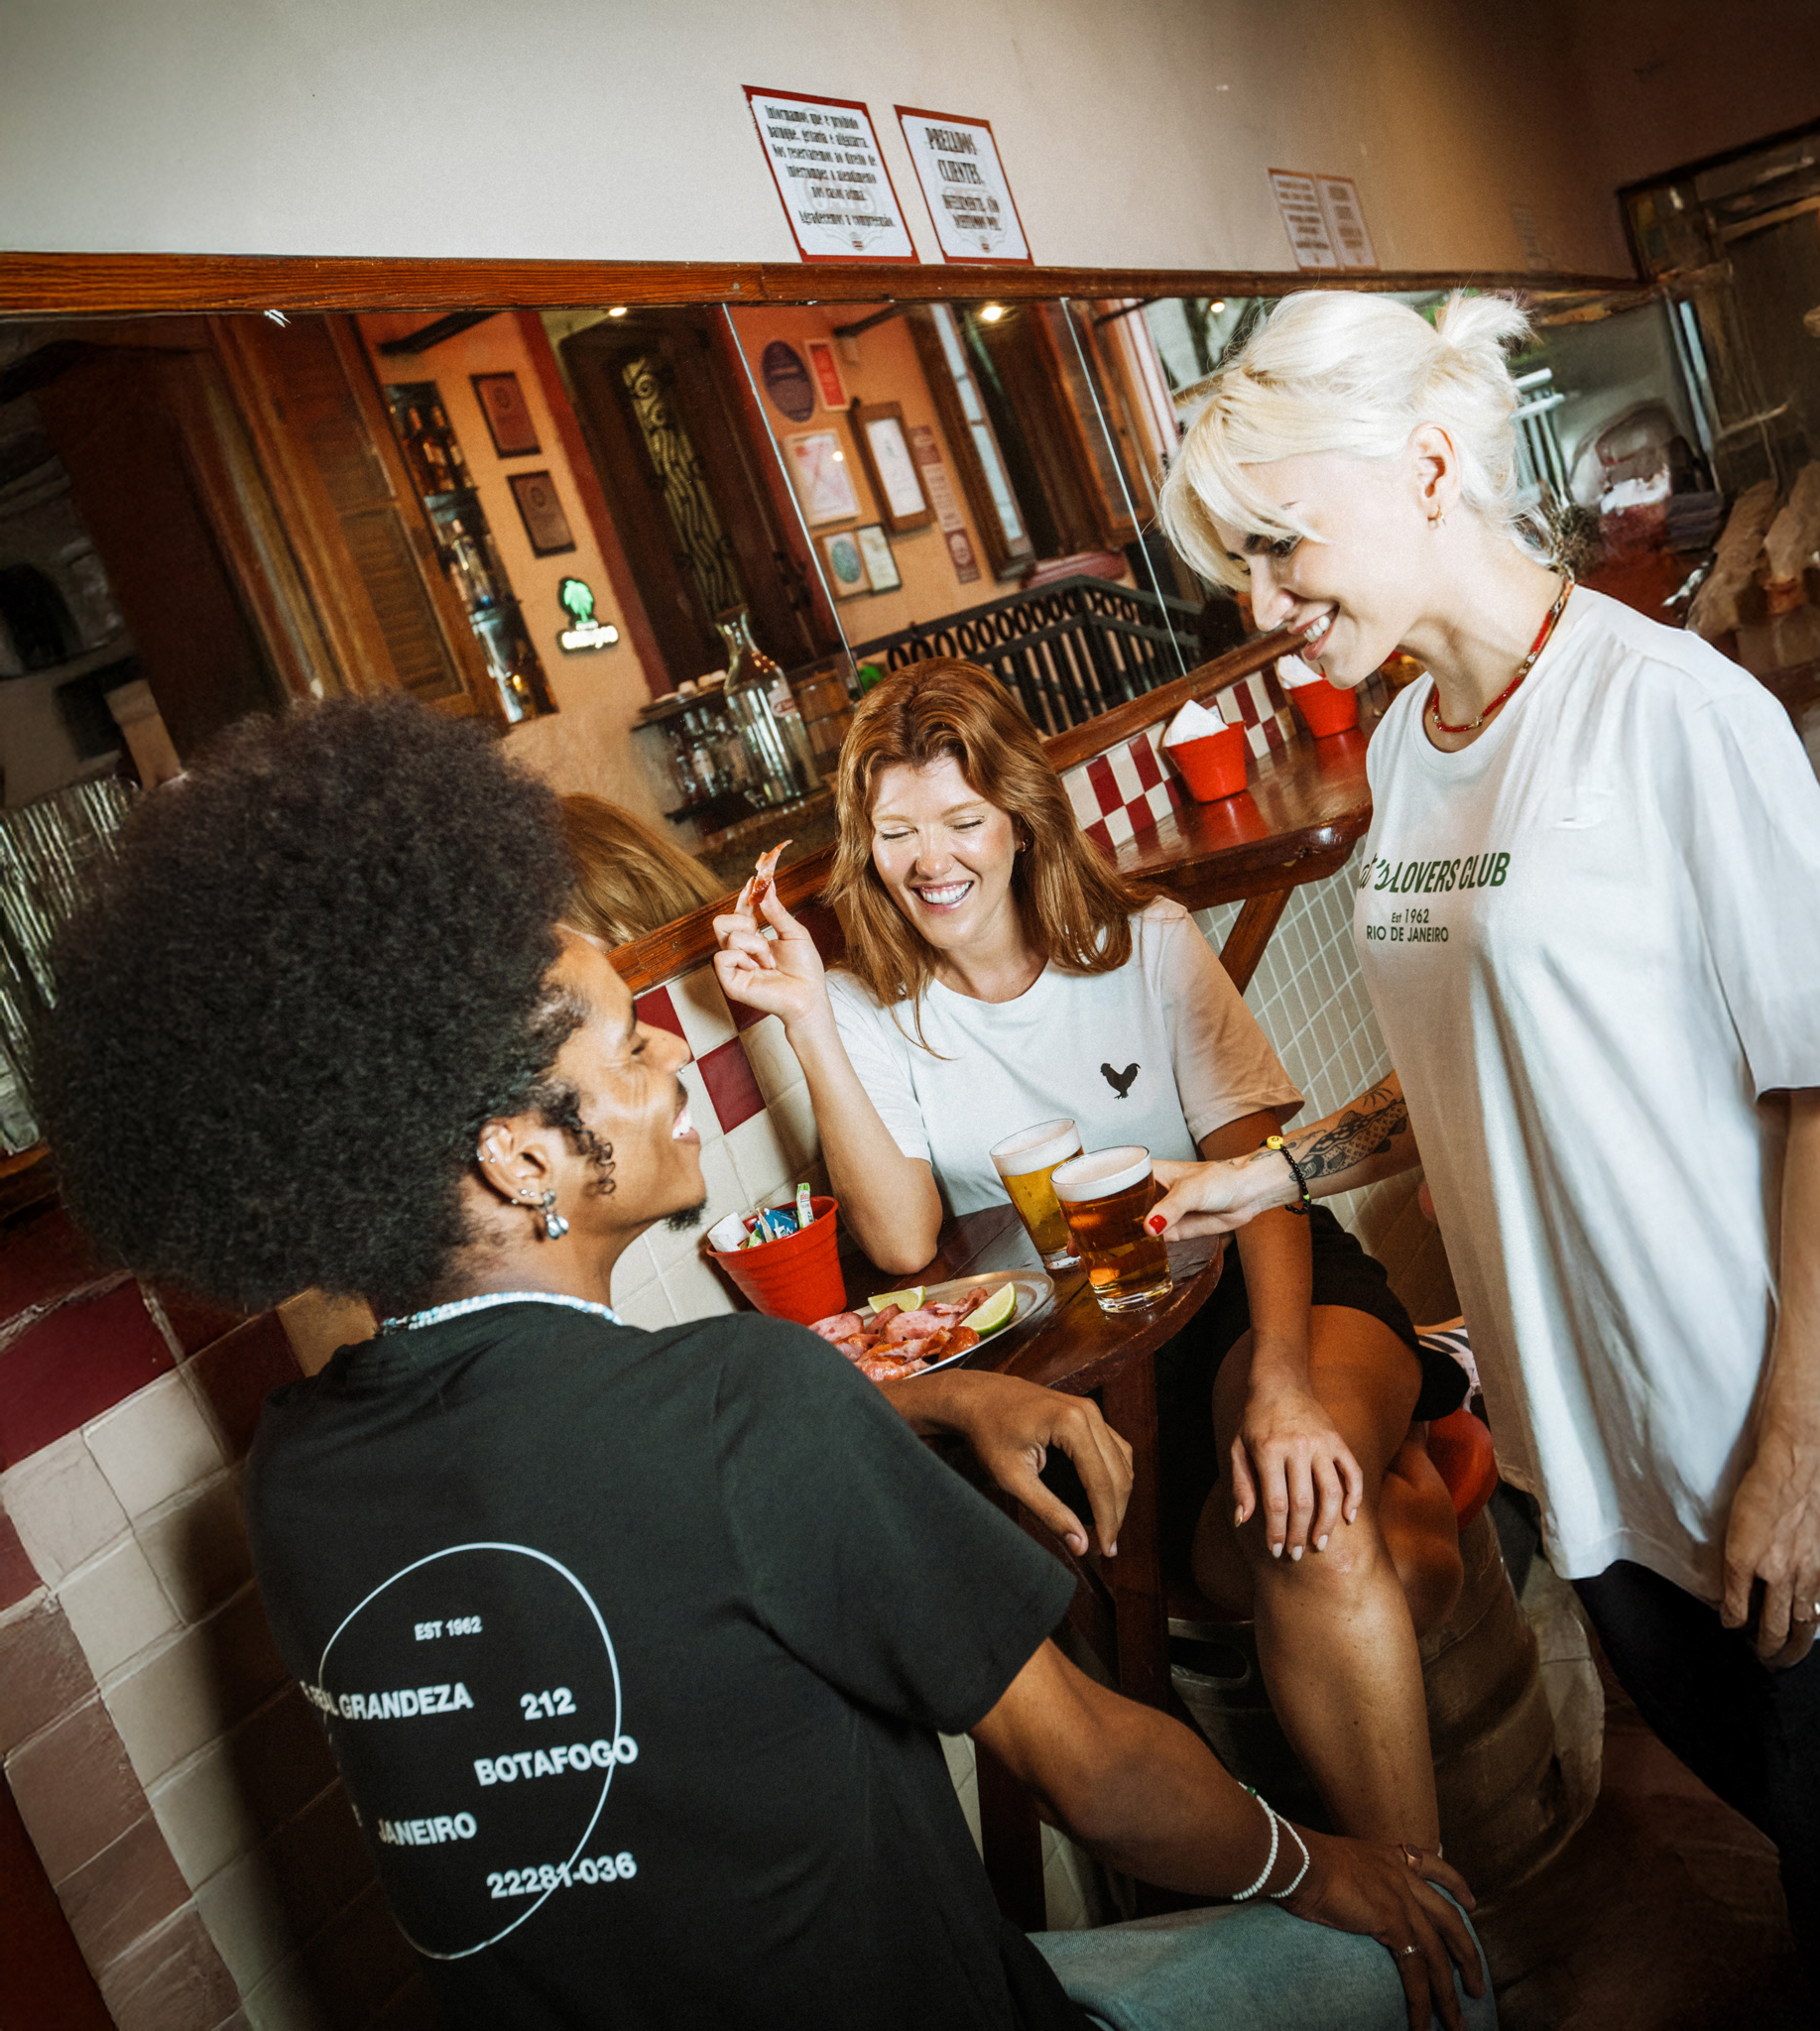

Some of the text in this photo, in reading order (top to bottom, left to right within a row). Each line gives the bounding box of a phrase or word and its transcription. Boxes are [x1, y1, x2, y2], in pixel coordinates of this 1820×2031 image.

[1359, 852, 1511, 894] at's LOVERS CLUB
[1392, 908, 1430, 924] Est 1962
[1366, 925, 1449, 942] RIO DE JANEIRO
[415, 1615, 483, 1641] EST 1962
[339, 1682, 474, 1721] GRANDEZA
[520, 1687, 577, 1721] 212
[473, 1735, 640, 1786] BOTAFOGO
[378, 1812, 478, 1846] JANEIRO
[486, 1852, 638, 1899] 22281-036
